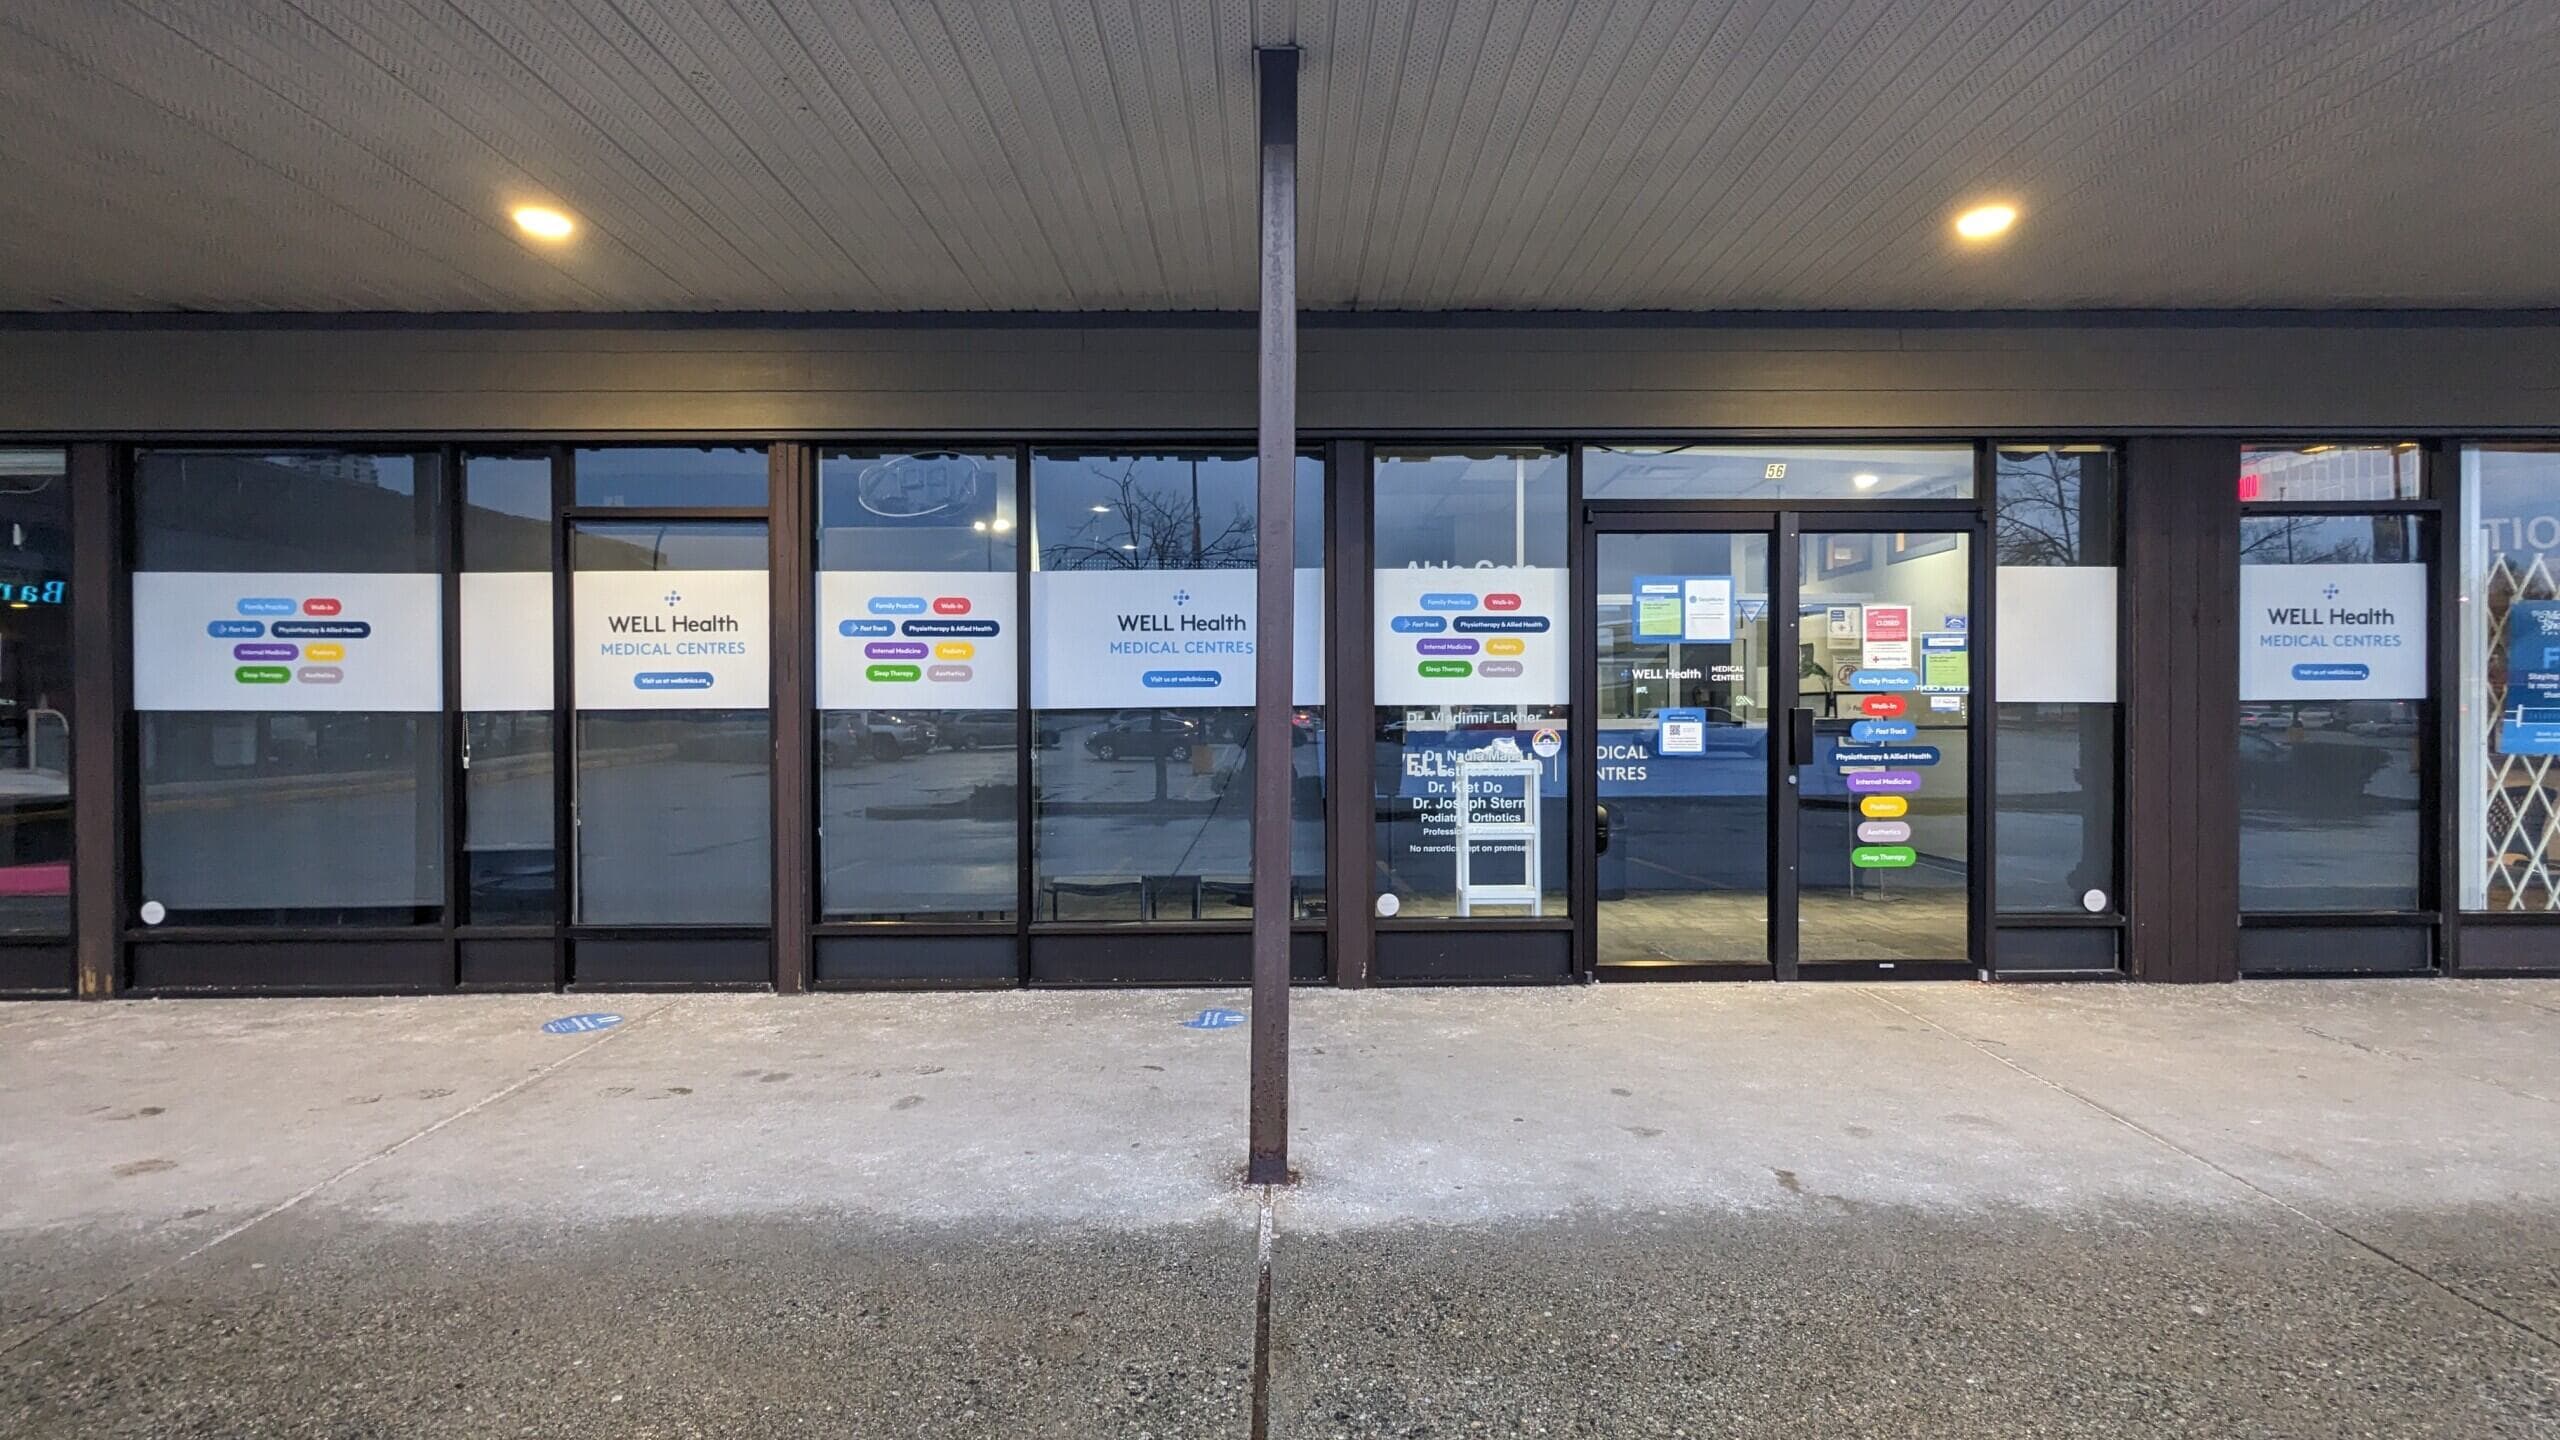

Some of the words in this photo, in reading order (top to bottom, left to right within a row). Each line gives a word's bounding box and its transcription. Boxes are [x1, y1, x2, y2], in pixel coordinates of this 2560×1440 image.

[1768, 464, 1785, 478] 56
[875, 603, 895, 611] Family
[1427, 599, 1447, 607] Family
[2267, 608, 2323, 625] WELL
[2330, 607, 2395, 625] Health
[608, 615, 666, 633] WELL
[672, 614, 739, 633] Health
[1117, 614, 1174, 632] WELL
[1180, 613, 1247, 632] Health
[1460, 621, 1501, 631] Physiotherapy
[278, 626, 320, 635] Physiotherapy
[909, 625, 950, 634] Physiotherapy
[2260, 634, 2328, 647] MEDICAL
[2333, 634, 2402, 647] CENTRES
[600, 642, 671, 656] MEDICAL
[676, 641, 746, 655] CENTRES
[1110, 641, 1180, 655] MEDICAL
[1184, 640, 1254, 655] CENTRES
[874, 670, 889, 678] Sleep
[890, 670, 914, 678] Therapy
[1425, 665, 1441, 674] Sleep
[1441, 665, 1466, 674] Therapy
[1632, 669, 1664, 680] WELL
[1665, 668, 1702, 679] Health
[1711, 665, 1745, 673] MEDICAL
[1711, 674, 1745, 682] CENTRES
[1858, 677, 1880, 685] Family
[1881, 677, 1909, 685] Practice
[1432, 712, 1489, 724] Vladimir
[1493, 712, 1542, 724] Lakher
[1836, 753, 1882, 761] Physiotherapy
[1402, 753, 1449, 775] ELL
[1428, 781, 1447, 793] Dr.
[1451, 781, 1479, 793] Ket
[1483, 781, 1503, 793] Do
[1412, 797, 1431, 809] Dr.
[1436, 797, 1486, 812] Josph
[1490, 797, 1527, 809] Stern
[1472, 813, 1521, 823] Orthotics
[1409, 844, 1421, 853] No
[1422, 844, 1460, 853] narcotic
[1482, 845, 1491, 853] on
[1494, 844, 1530, 854] premise
[1861, 854, 1880, 862] Sleep
[1880, 854, 1907, 862] Therapy
